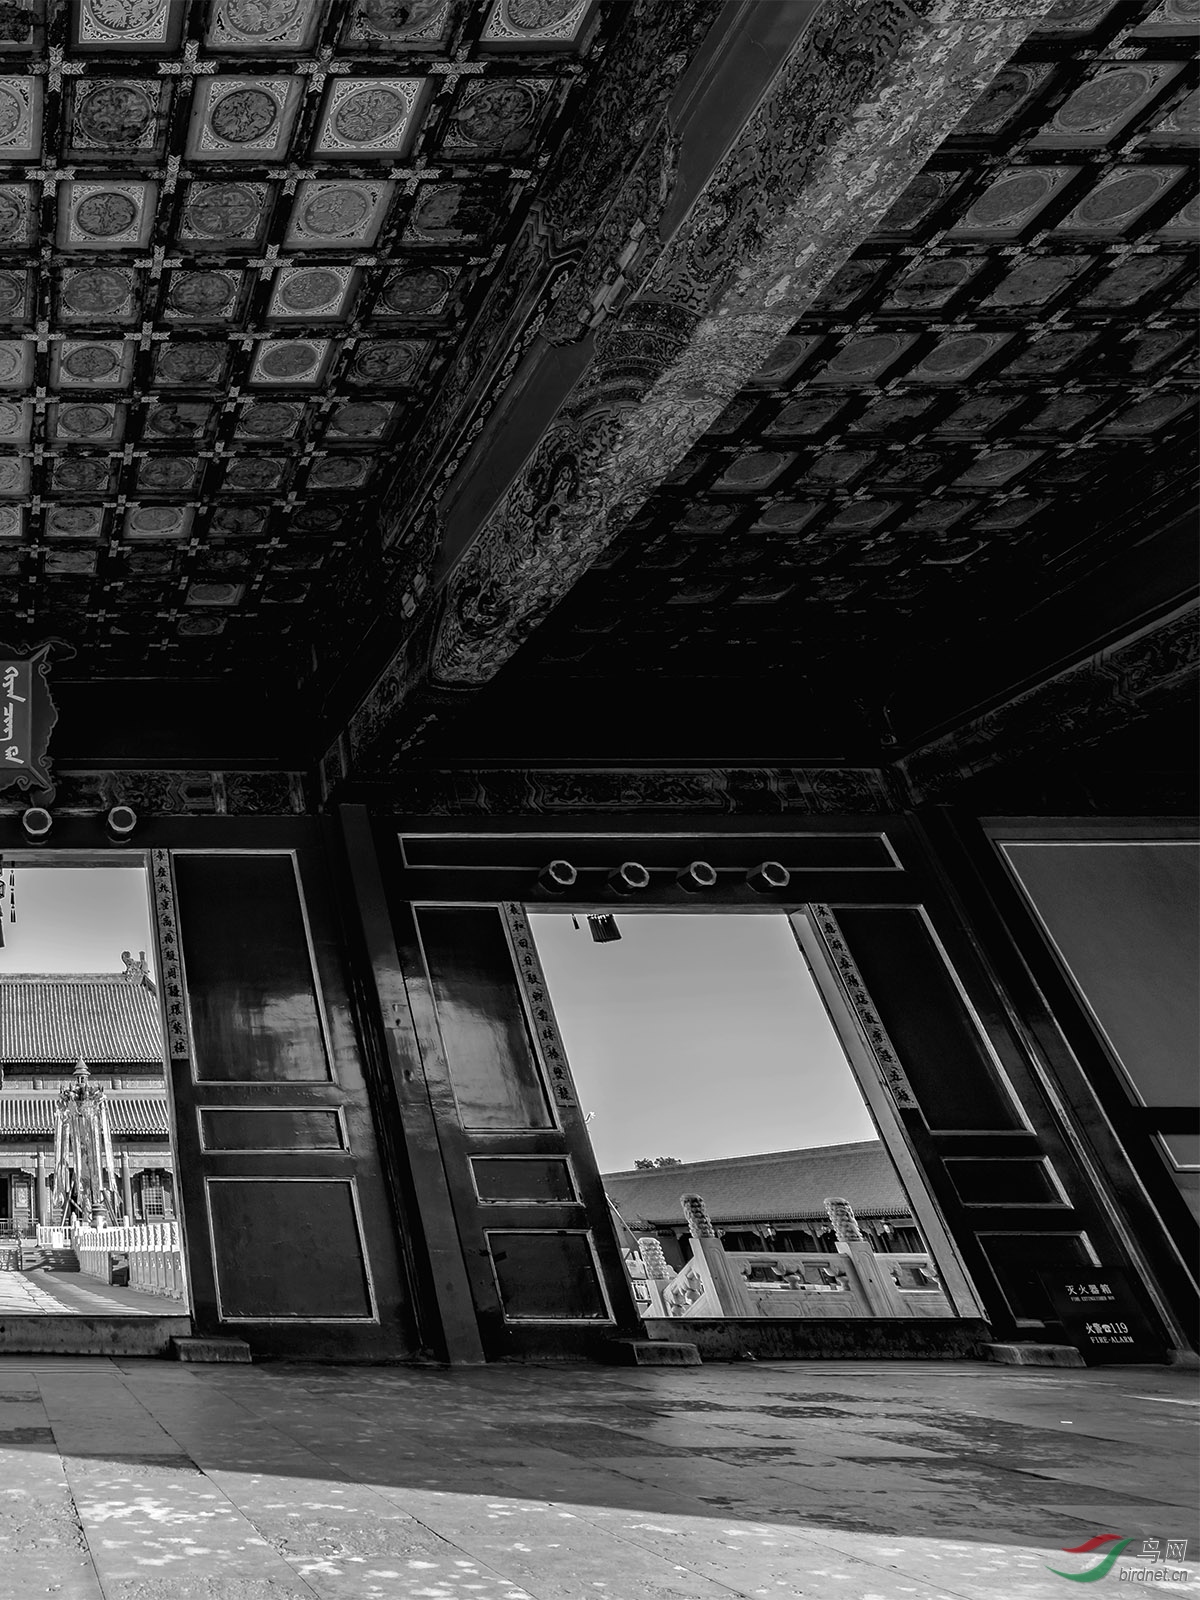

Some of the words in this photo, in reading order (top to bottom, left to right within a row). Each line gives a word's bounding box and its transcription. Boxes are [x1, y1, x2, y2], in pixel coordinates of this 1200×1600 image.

[1065, 1284, 1112, 1295] 灭火器箱
[1110, 1322, 1128, 1334] 119
